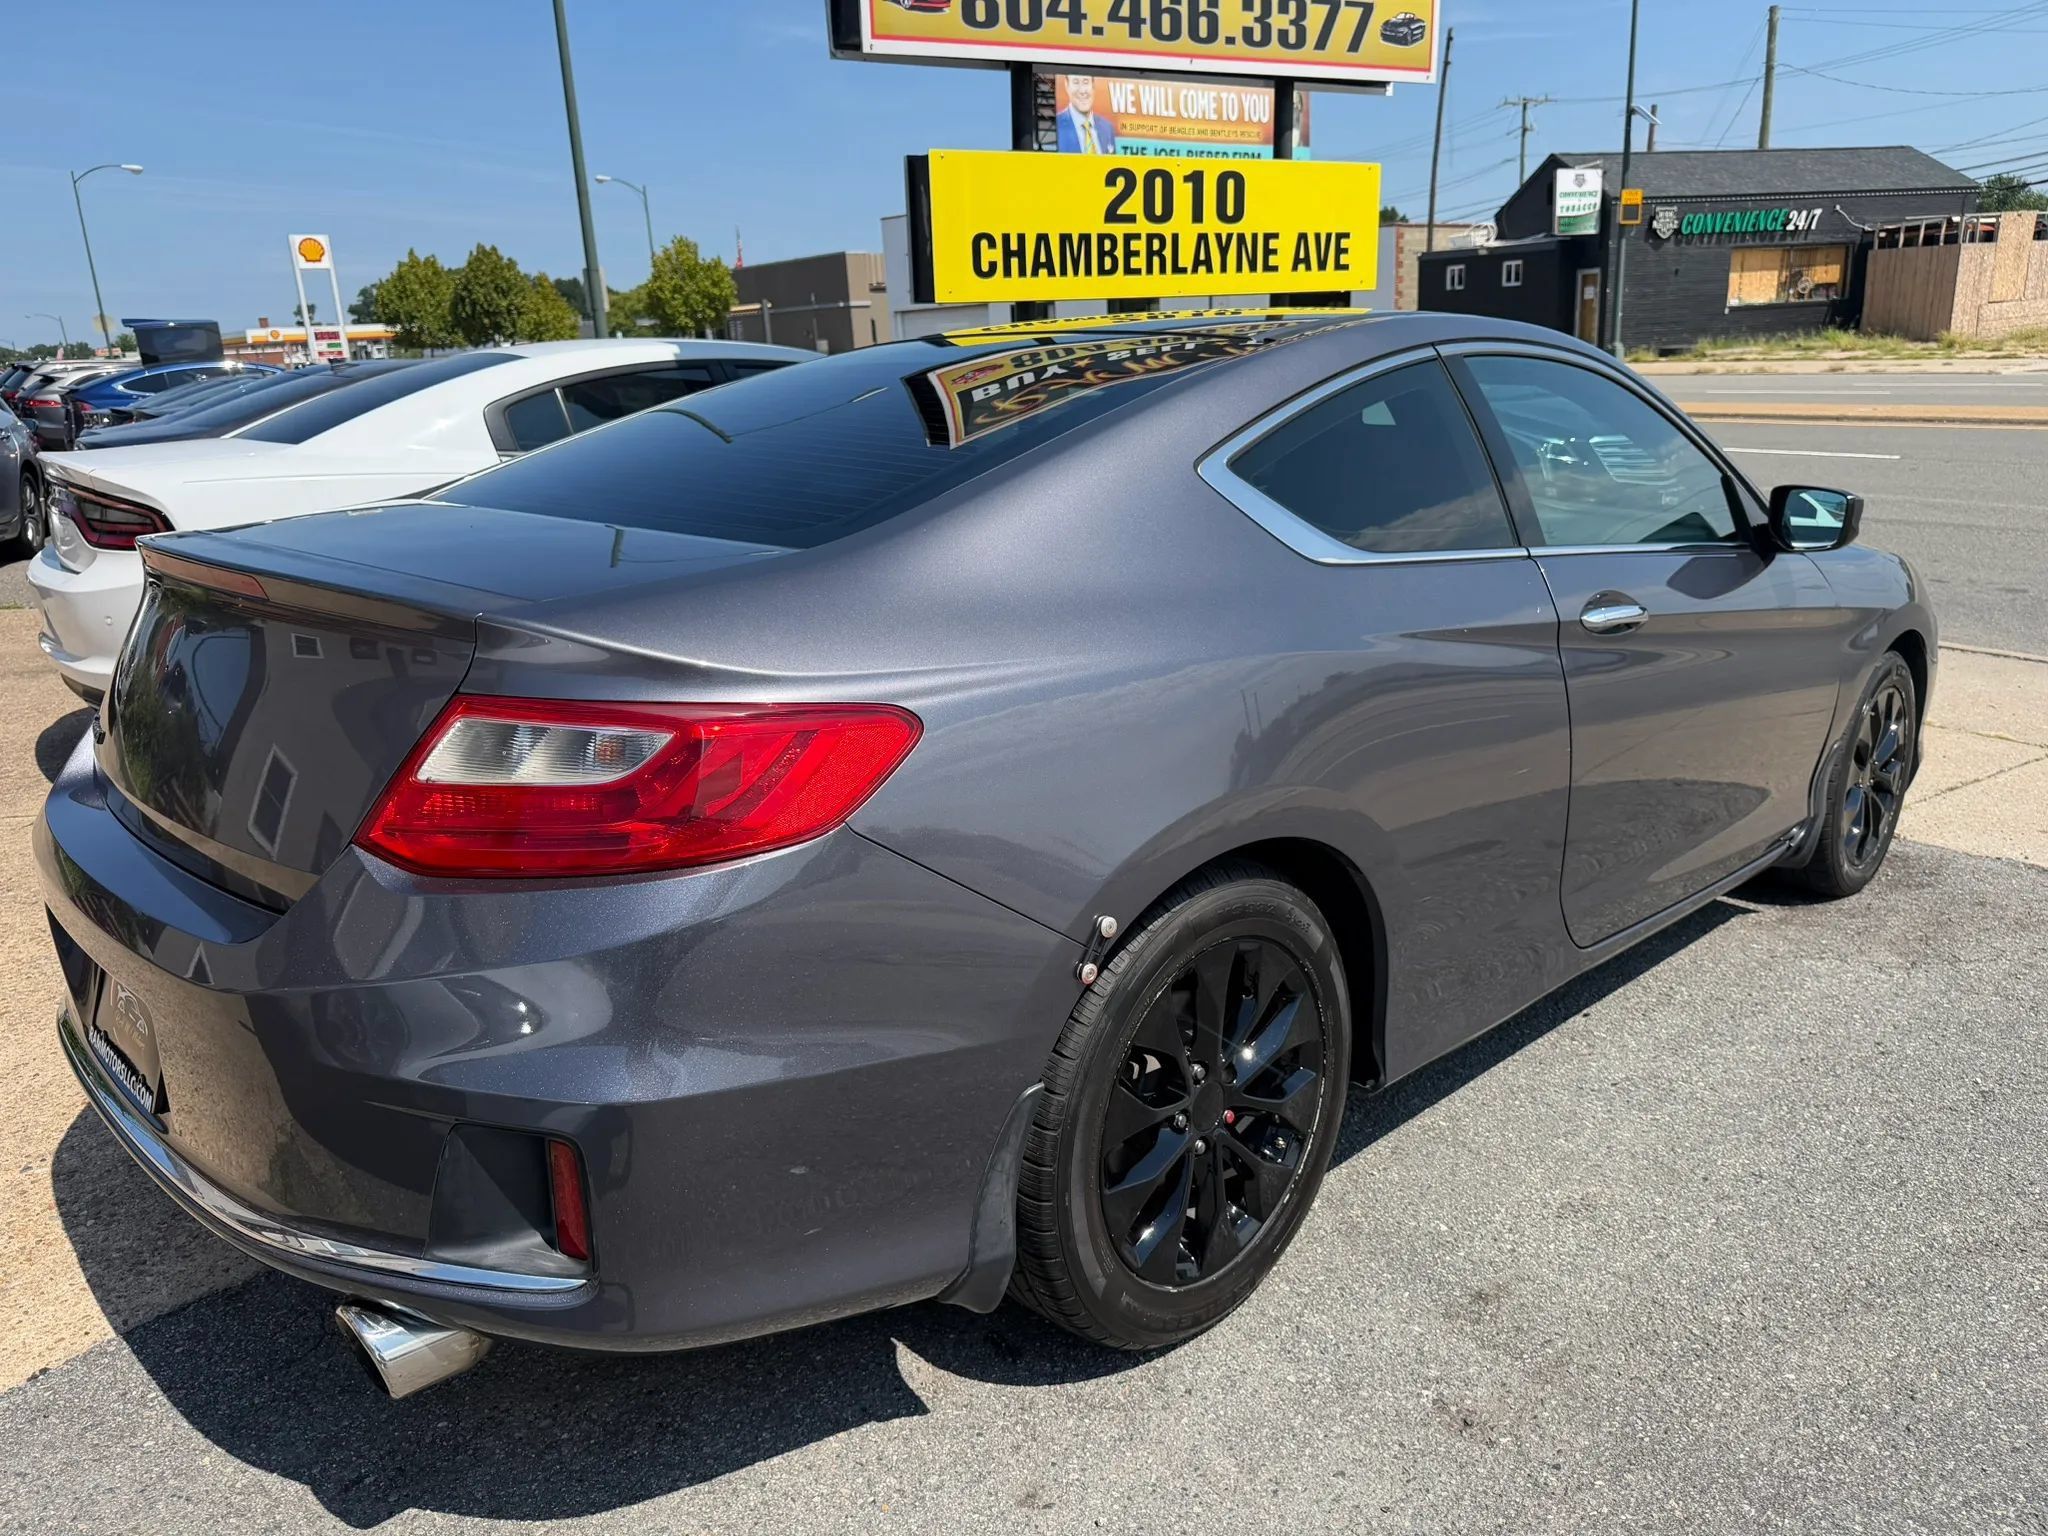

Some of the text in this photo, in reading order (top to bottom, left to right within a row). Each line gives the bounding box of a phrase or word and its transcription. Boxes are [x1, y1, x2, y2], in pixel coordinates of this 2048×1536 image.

[1109, 82, 1270, 123] WE WILL COME TO YOU
[1129, 123, 1158, 132] SUPPORT
[1104, 167, 1245, 225] 2010
[1560, 202, 1598, 213] TOBACCO
[1681, 208, 1789, 235] CONVENIENCE
[1786, 208, 1823, 231] 24/7
[971, 231, 1351, 280] CHAMBERLAYNE AVE
